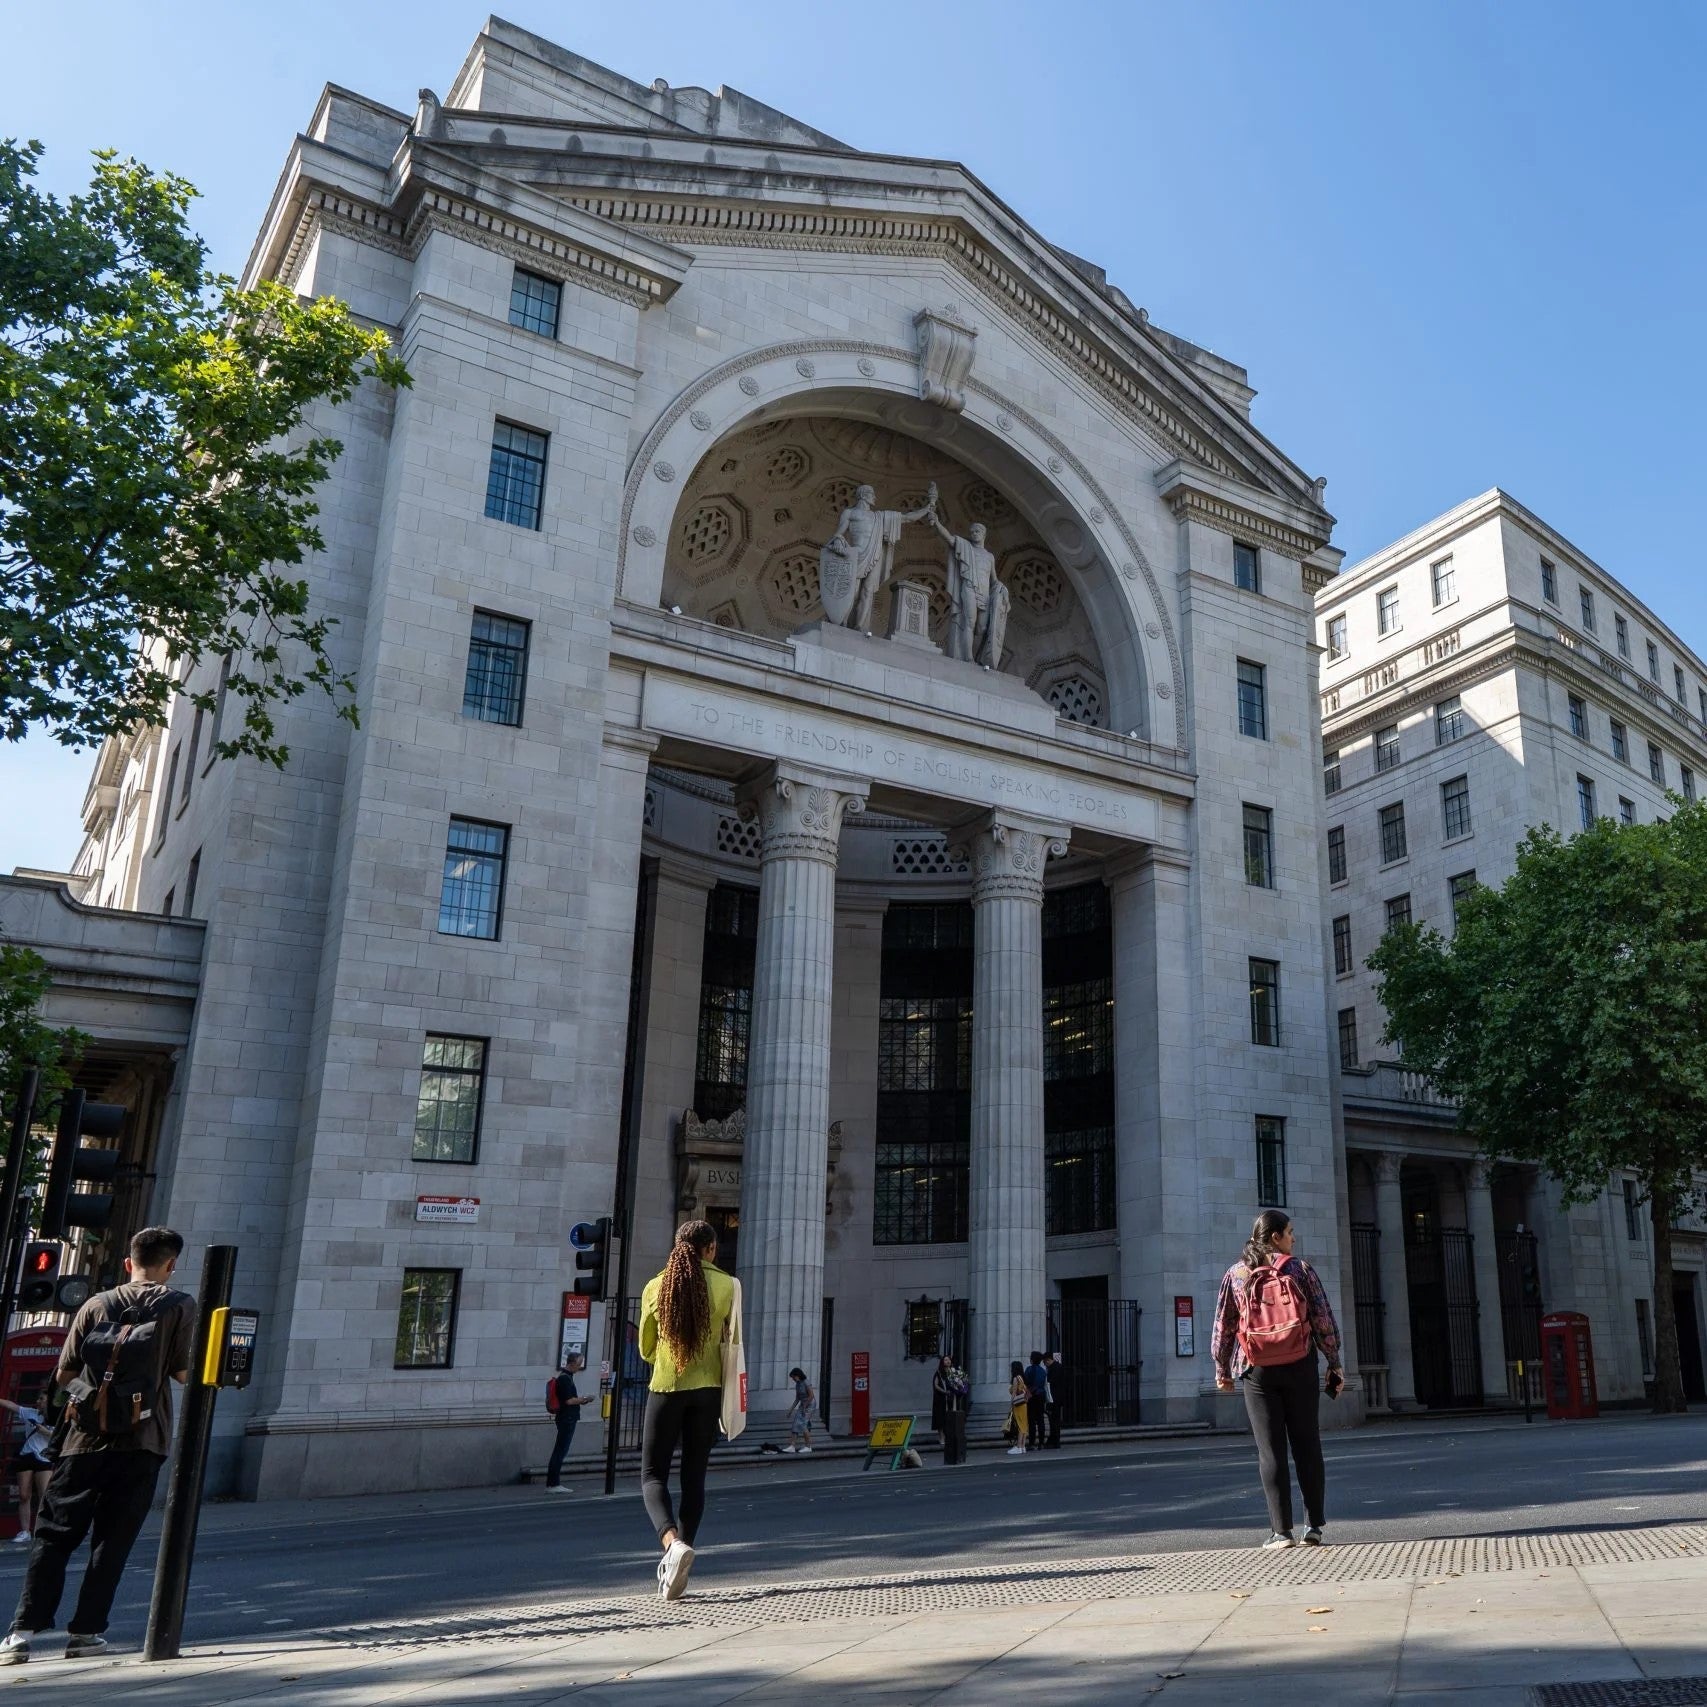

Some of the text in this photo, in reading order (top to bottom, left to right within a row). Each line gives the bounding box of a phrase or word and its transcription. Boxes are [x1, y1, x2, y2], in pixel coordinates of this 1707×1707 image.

[691, 703, 1128, 820] TO THE FRIENDSHIP OF ENGLISH SPEAKING PEOPLES
[422, 1205, 475, 1215] ALDWYCH WC2
[231, 1335, 253, 1346] WAIT
[15, 1346, 62, 1356] TELEPHO
